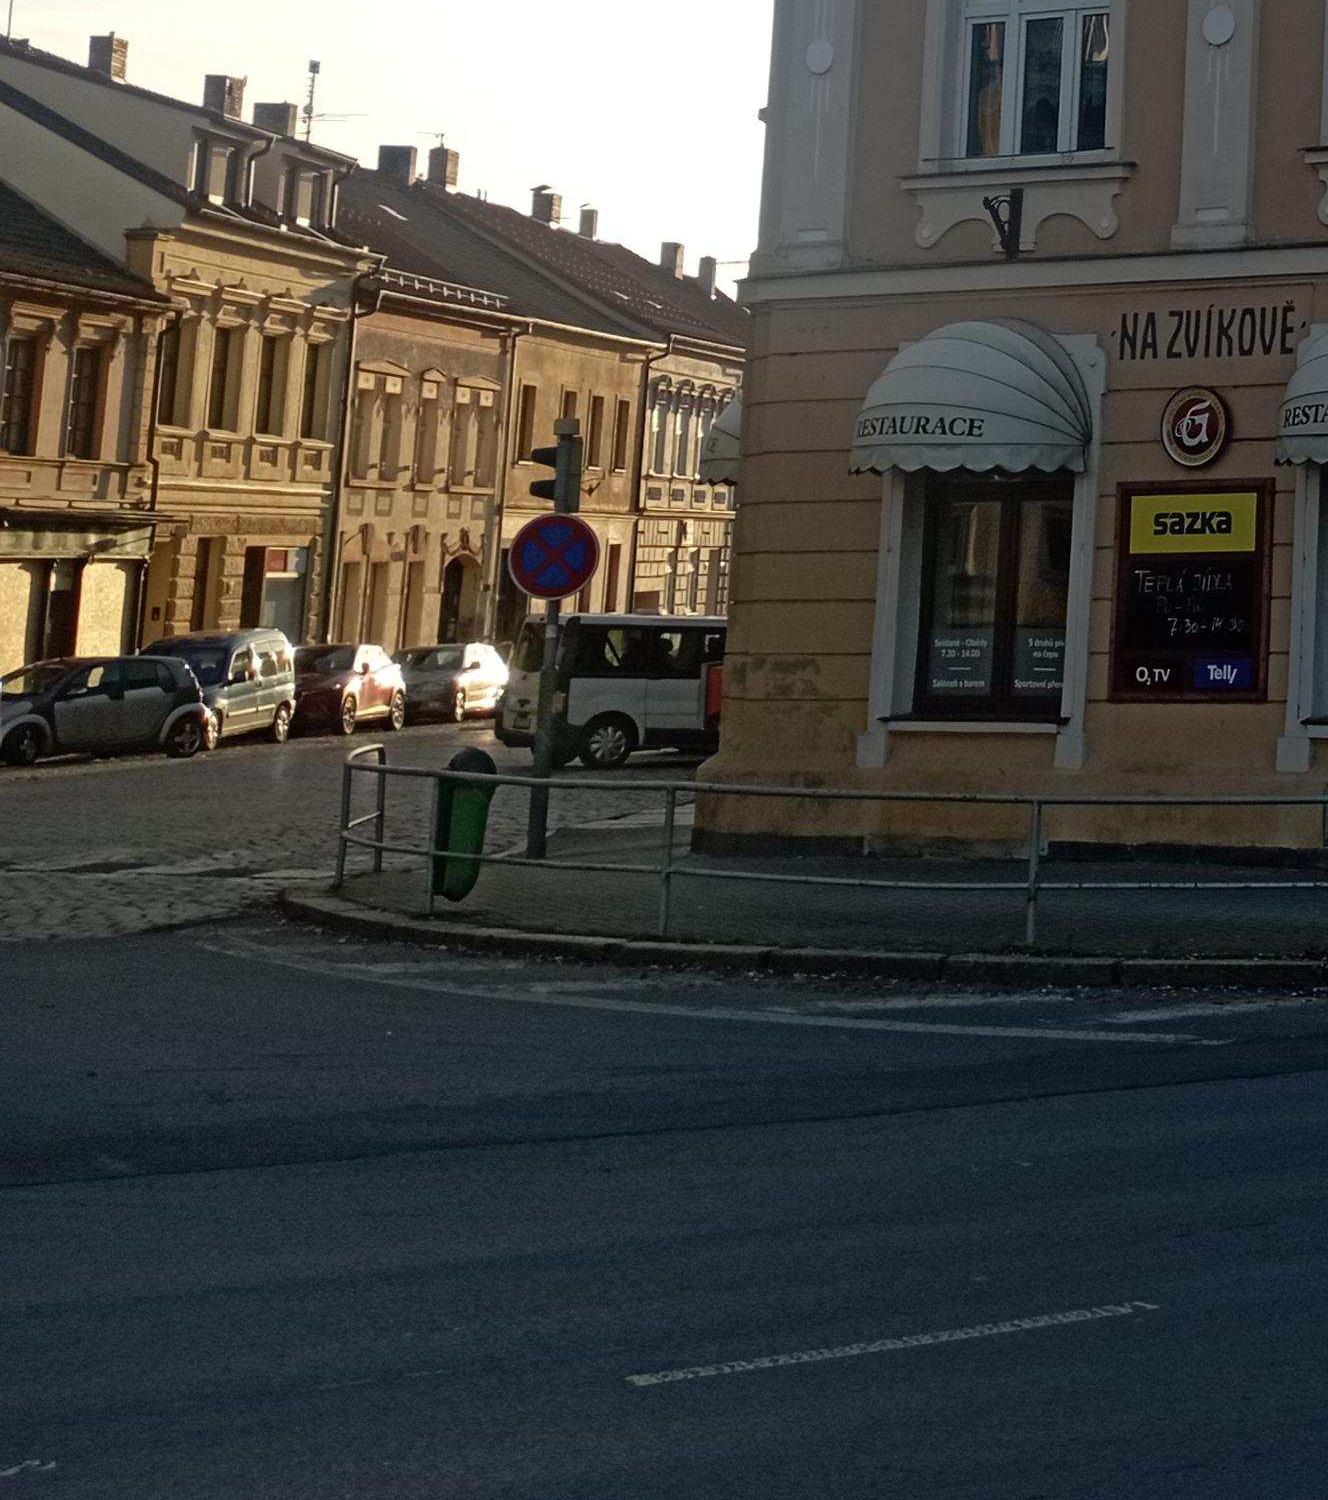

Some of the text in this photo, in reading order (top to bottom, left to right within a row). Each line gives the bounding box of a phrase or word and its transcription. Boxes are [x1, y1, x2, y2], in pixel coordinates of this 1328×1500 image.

[1119, 300, 1296, 360] NA ZVÍKOVĚ
[855, 415, 986, 439] RESTAURACE
[1207, 664, 1238, 685] Telly
